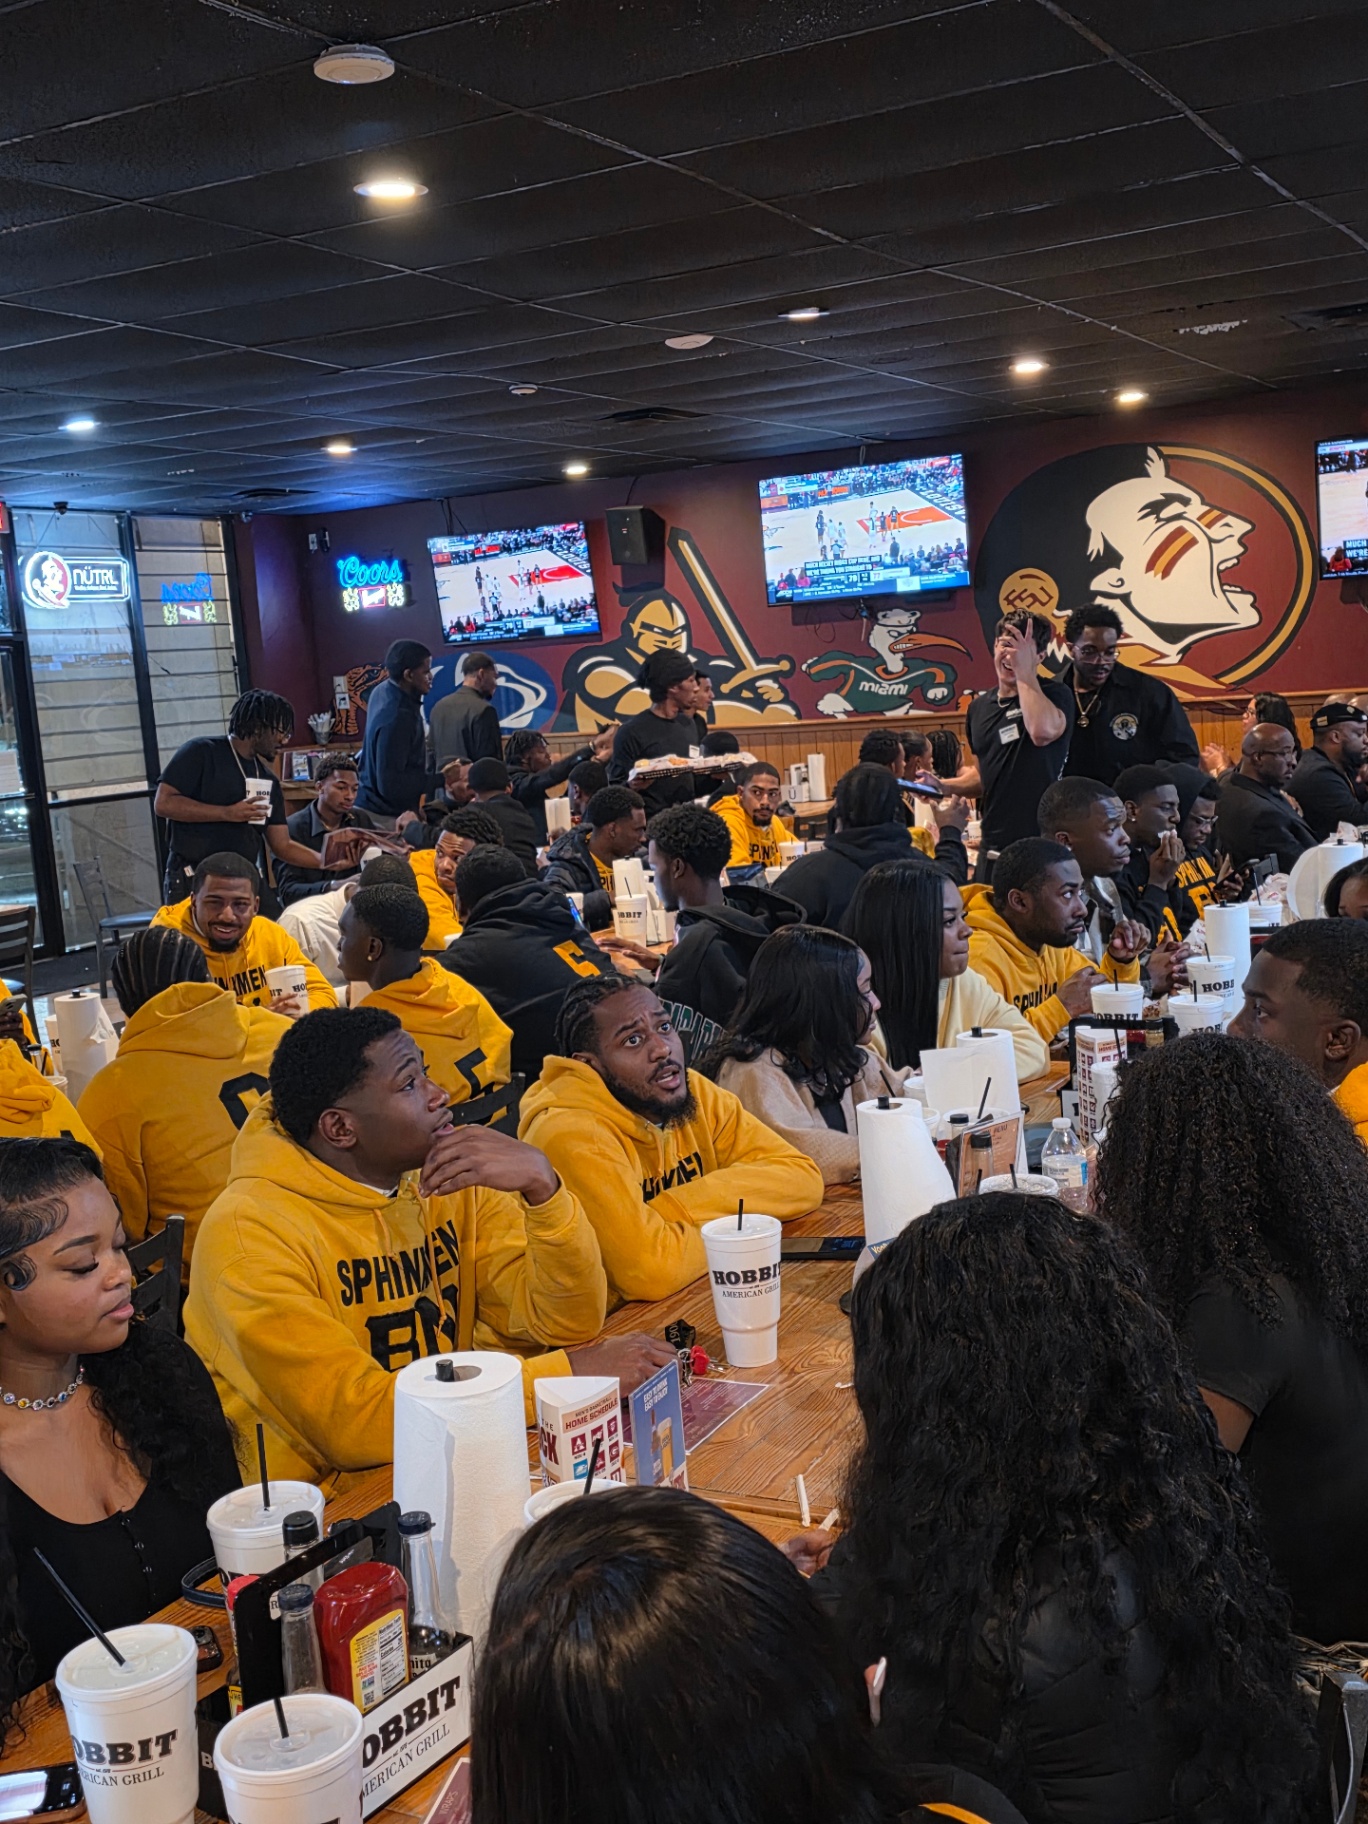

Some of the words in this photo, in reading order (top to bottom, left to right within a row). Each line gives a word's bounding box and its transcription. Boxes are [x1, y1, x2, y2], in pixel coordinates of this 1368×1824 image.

[1346, 540, 1367, 548] MUCH
[337, 556, 403, 588] Coors
[712, 1260, 781, 1285] HOBBI
[722, 1288, 763, 1299] AMERICAN
[565, 1416, 589, 1430] HOME
[589, 1398, 619, 1420] SCHEDULE
[416, 1723, 451, 1758] GRILL
[122, 1766, 165, 1786] GRILL
